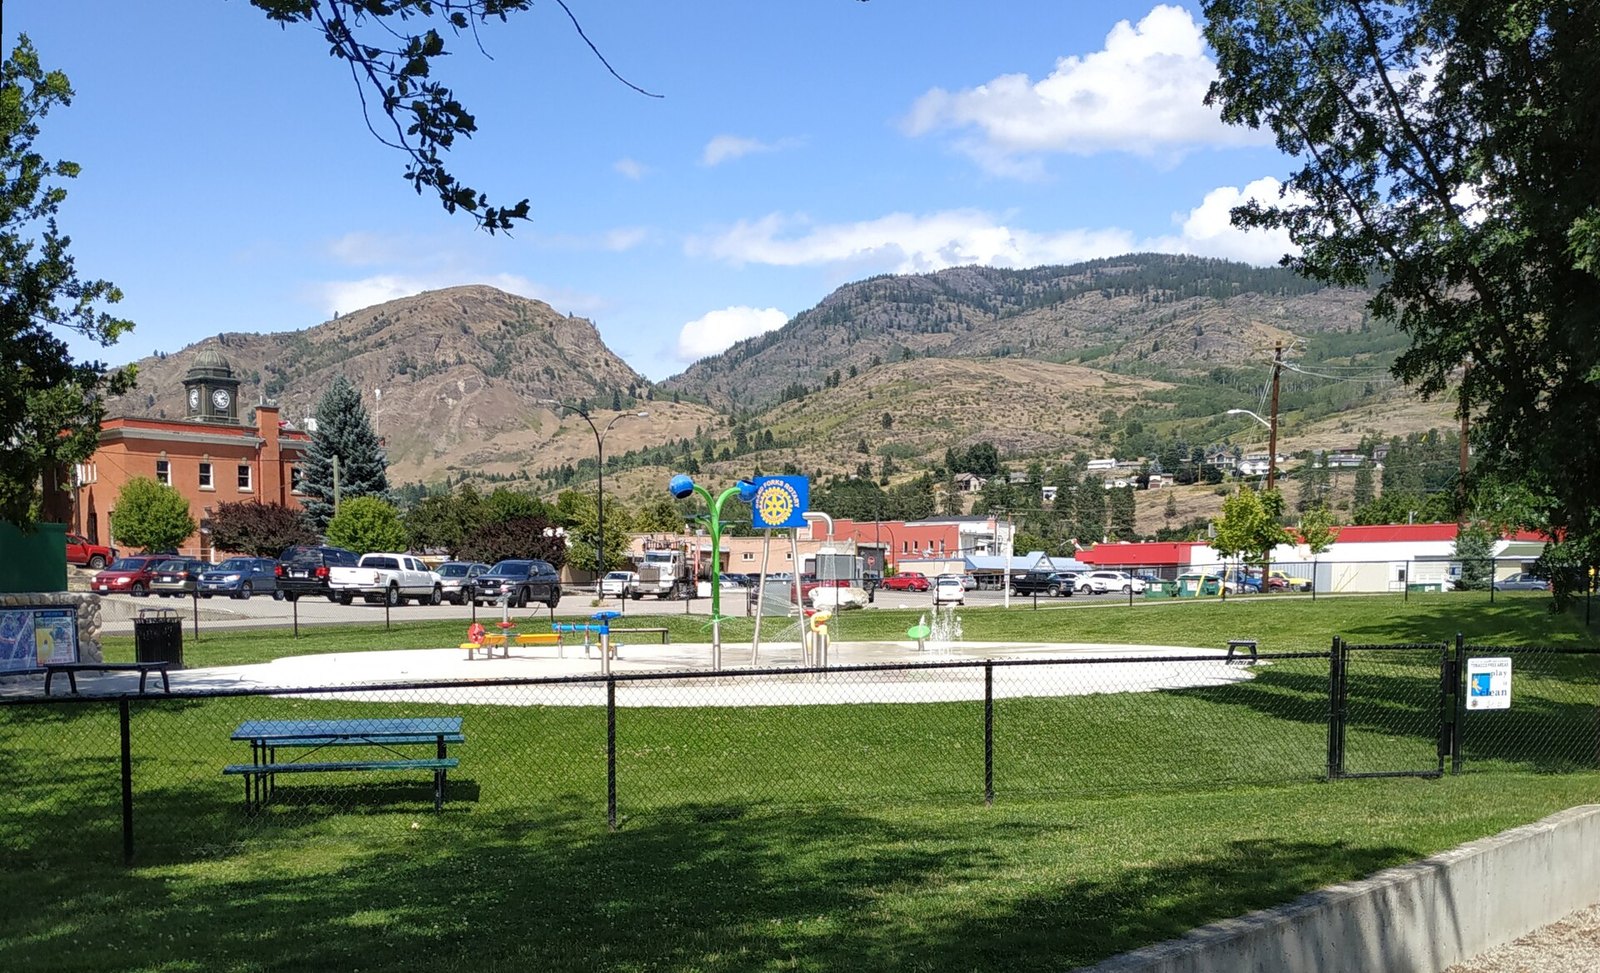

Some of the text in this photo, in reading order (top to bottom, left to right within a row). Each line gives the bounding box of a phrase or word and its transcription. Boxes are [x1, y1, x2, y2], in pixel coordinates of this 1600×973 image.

[763, 479, 784, 488] FORKS
[784, 483, 800, 508] ROTARY
[1490, 669, 1507, 678] play
[1480, 688, 1507, 696] clean
